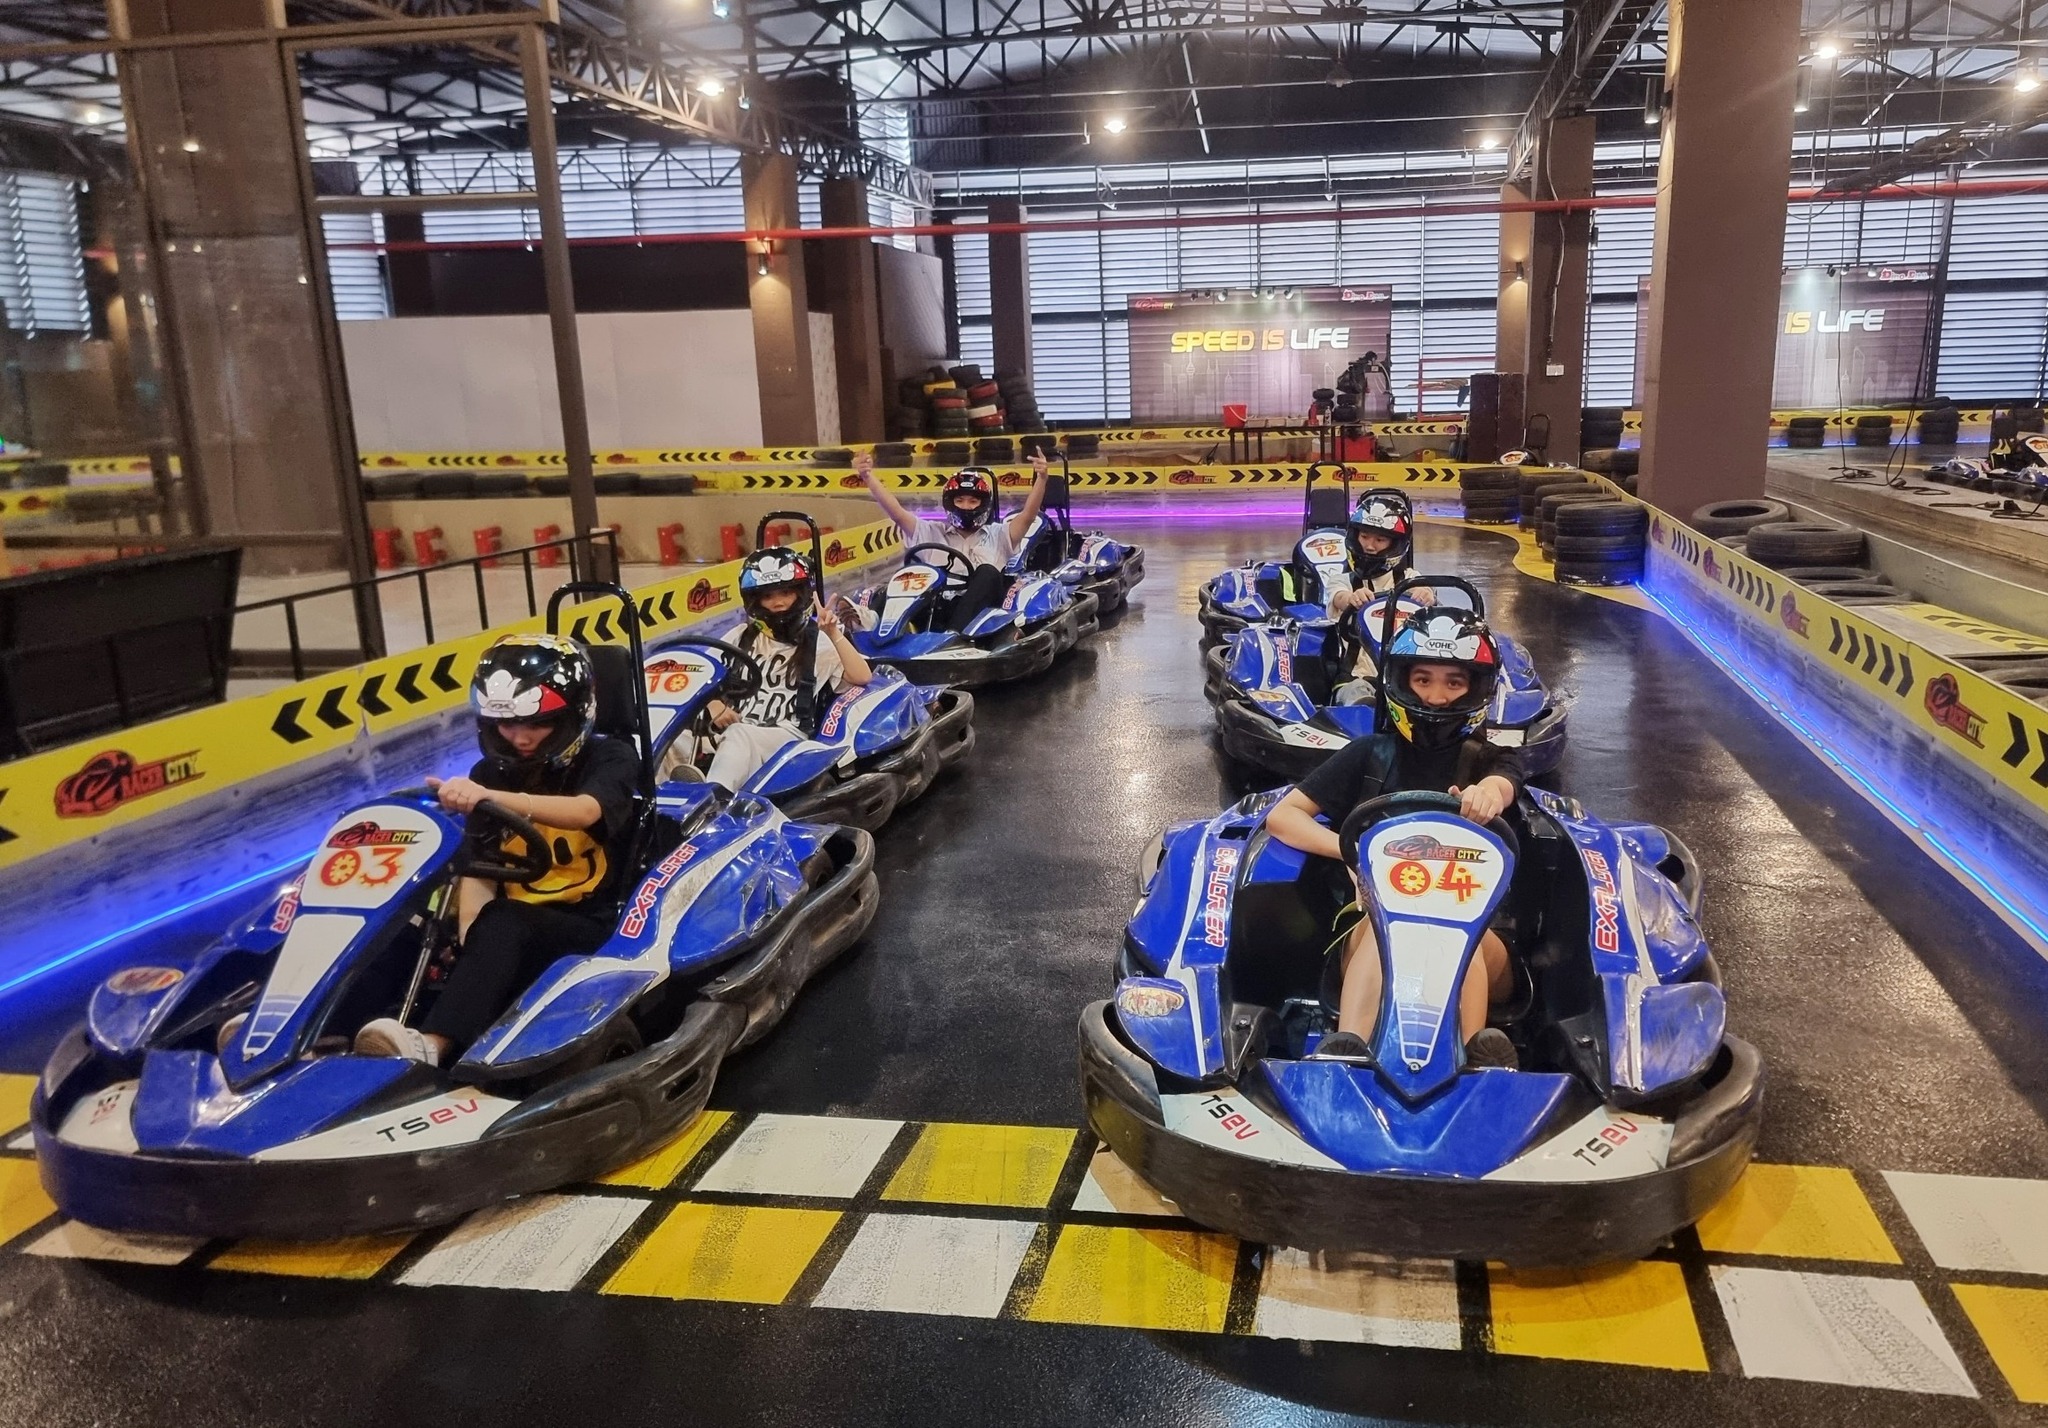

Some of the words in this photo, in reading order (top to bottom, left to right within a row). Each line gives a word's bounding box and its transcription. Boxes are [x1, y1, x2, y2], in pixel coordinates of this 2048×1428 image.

[1784, 311, 1812, 334] IS
[1817, 308, 1886, 333] LIFE
[1170, 331, 1255, 354] SPEED
[1261, 329, 1285, 351] IS
[1290, 327, 1351, 351] LIFE
[901, 578, 927, 592] 13
[1428, 640, 1454, 650] YOHE
[391, 831, 417, 843] CITY
[320, 846, 407, 888] 03
[1425, 847, 1457, 860] RACER
[1456, 849, 1482, 861] CITY
[619, 843, 700, 939] EXPLORER
[1388, 859, 1484, 903] 04
[1204, 847, 1238, 948] EXPLORER
